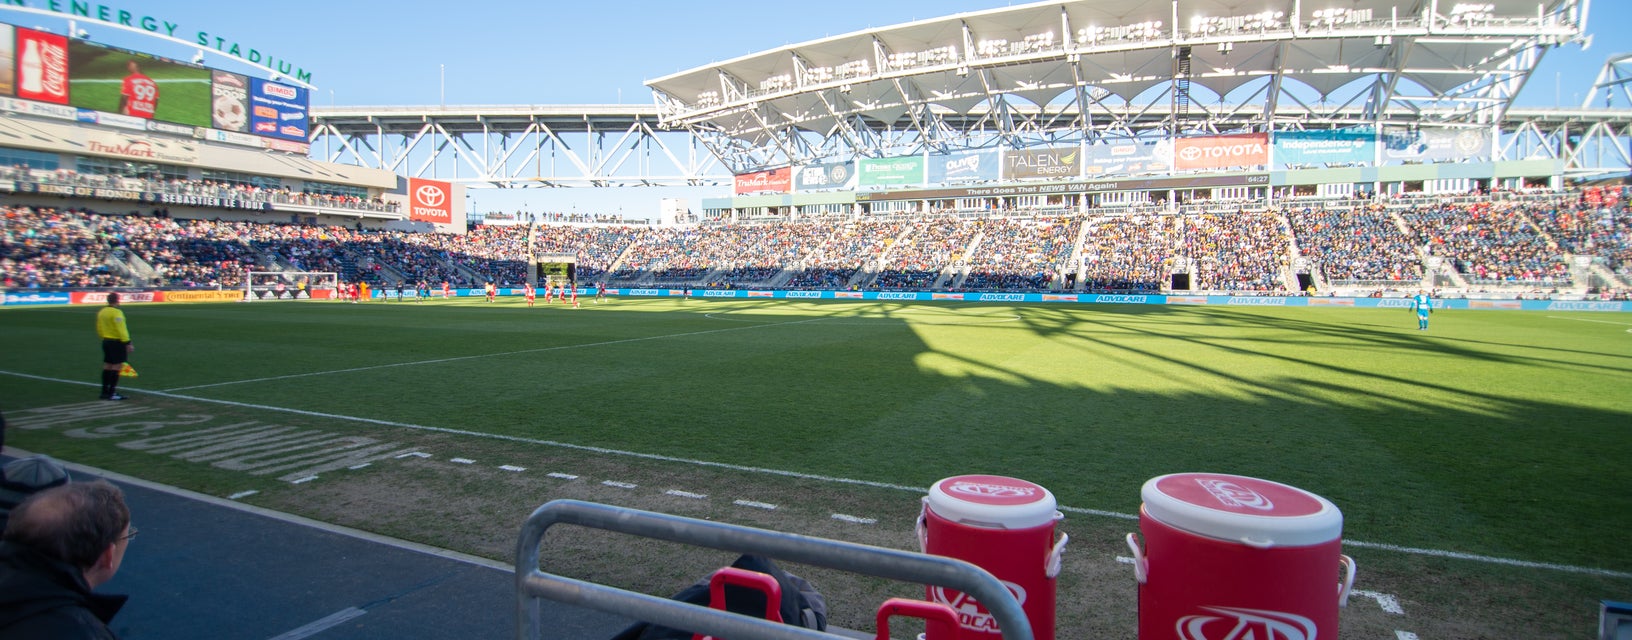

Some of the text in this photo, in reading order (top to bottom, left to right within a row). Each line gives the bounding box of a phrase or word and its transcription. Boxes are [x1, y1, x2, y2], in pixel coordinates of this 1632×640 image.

[47, 0, 312, 84] ENERGY STADIUM
[134, 84, 156, 101] 99
[266, 85, 295, 97] BIMBO
[88, 140, 156, 158] TruMark
[1282, 139, 1353, 150] Independence
[1203, 143, 1264, 158] TOYOTA
[1008, 154, 1059, 168] TALEN
[1037, 166, 1073, 174] ENERGY
[38, 183, 140, 200] RING OF HONOR
[1039, 184, 1066, 192] NEWS
[1068, 183, 1088, 191] VAN
[1088, 182, 1118, 191] Again!
[224, 199, 236, 208] LE
[240, 200, 265, 210] TOUX
[413, 206, 449, 218] TOYOTA
[166, 291, 215, 301] Continental
[1097, 295, 1146, 303] ADVOCARE
[1229, 297, 1285, 305] ADVOCARE
[1549, 301, 1622, 310] ADVOCARE
